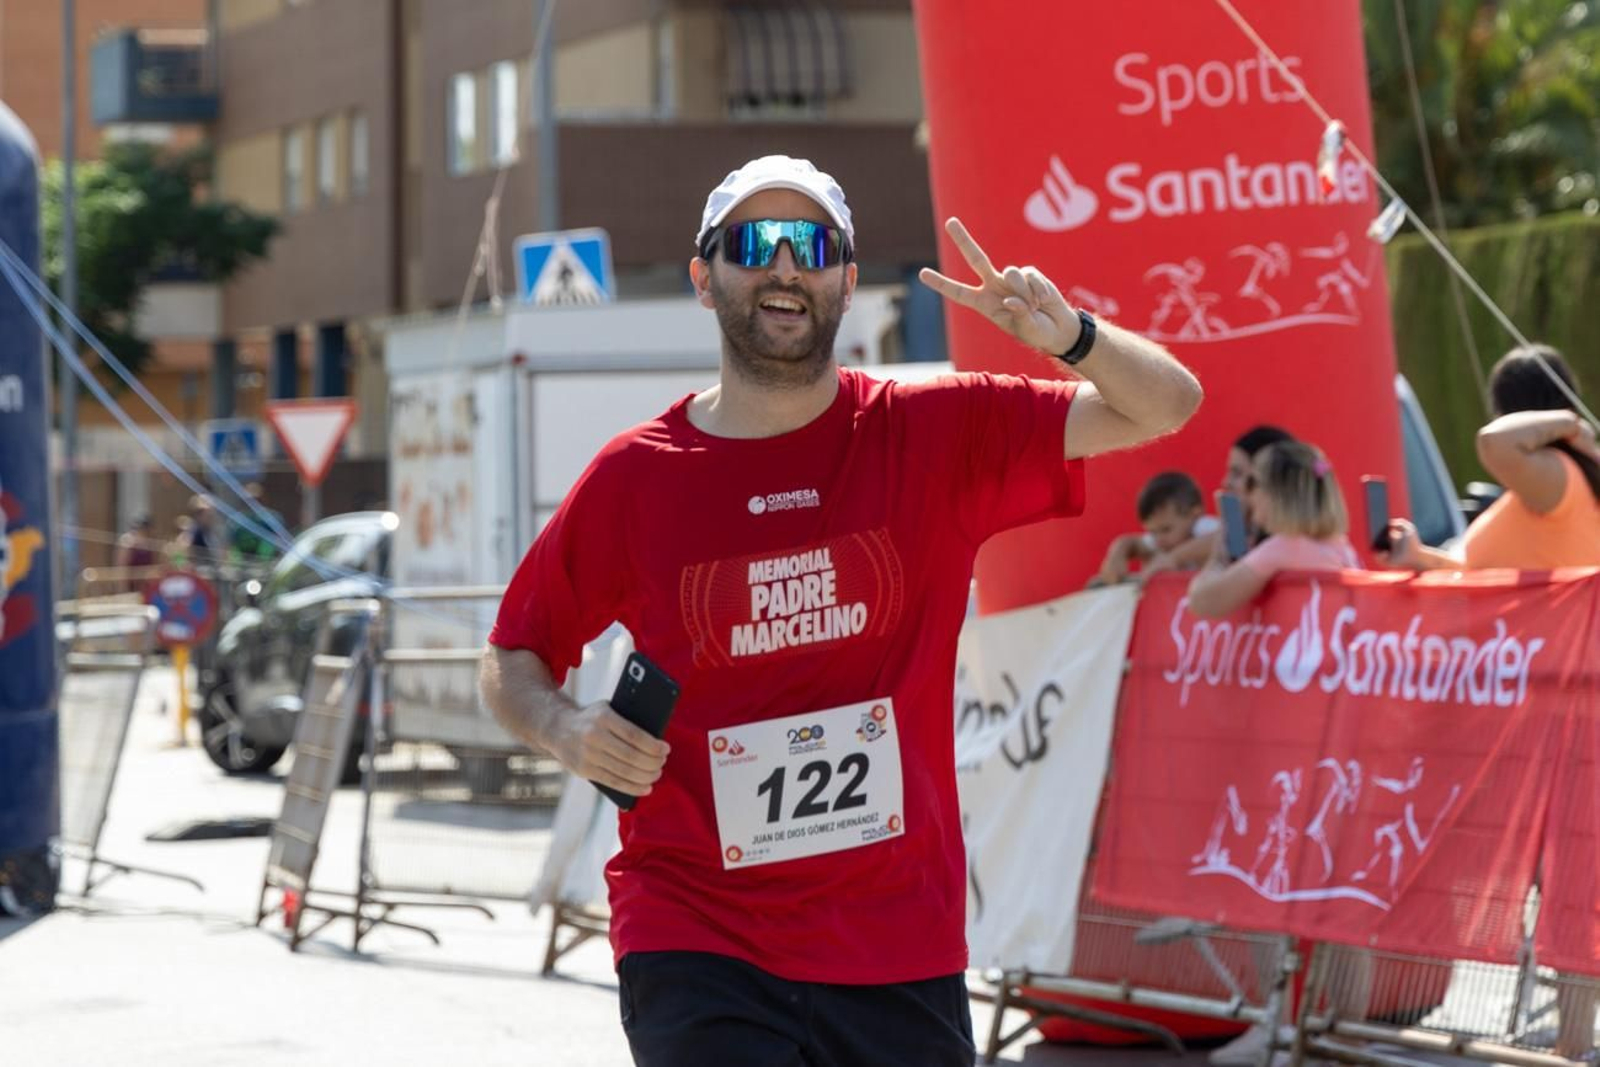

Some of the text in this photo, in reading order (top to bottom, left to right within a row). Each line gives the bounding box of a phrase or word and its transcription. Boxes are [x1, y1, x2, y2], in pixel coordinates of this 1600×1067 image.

[1113, 48, 1302, 127] Sports
[766, 488, 819, 504] OXIMESA
[748, 547, 833, 584] MEMORIAL
[751, 569, 836, 621] PADRE
[730, 602, 867, 657] MARCELINO
[1163, 596, 1545, 708] Sports Santander
[757, 752, 869, 824] 122
[752, 812, 879, 845] JUAN DE DIOS GÓMEZ HERNÁNDEZ
